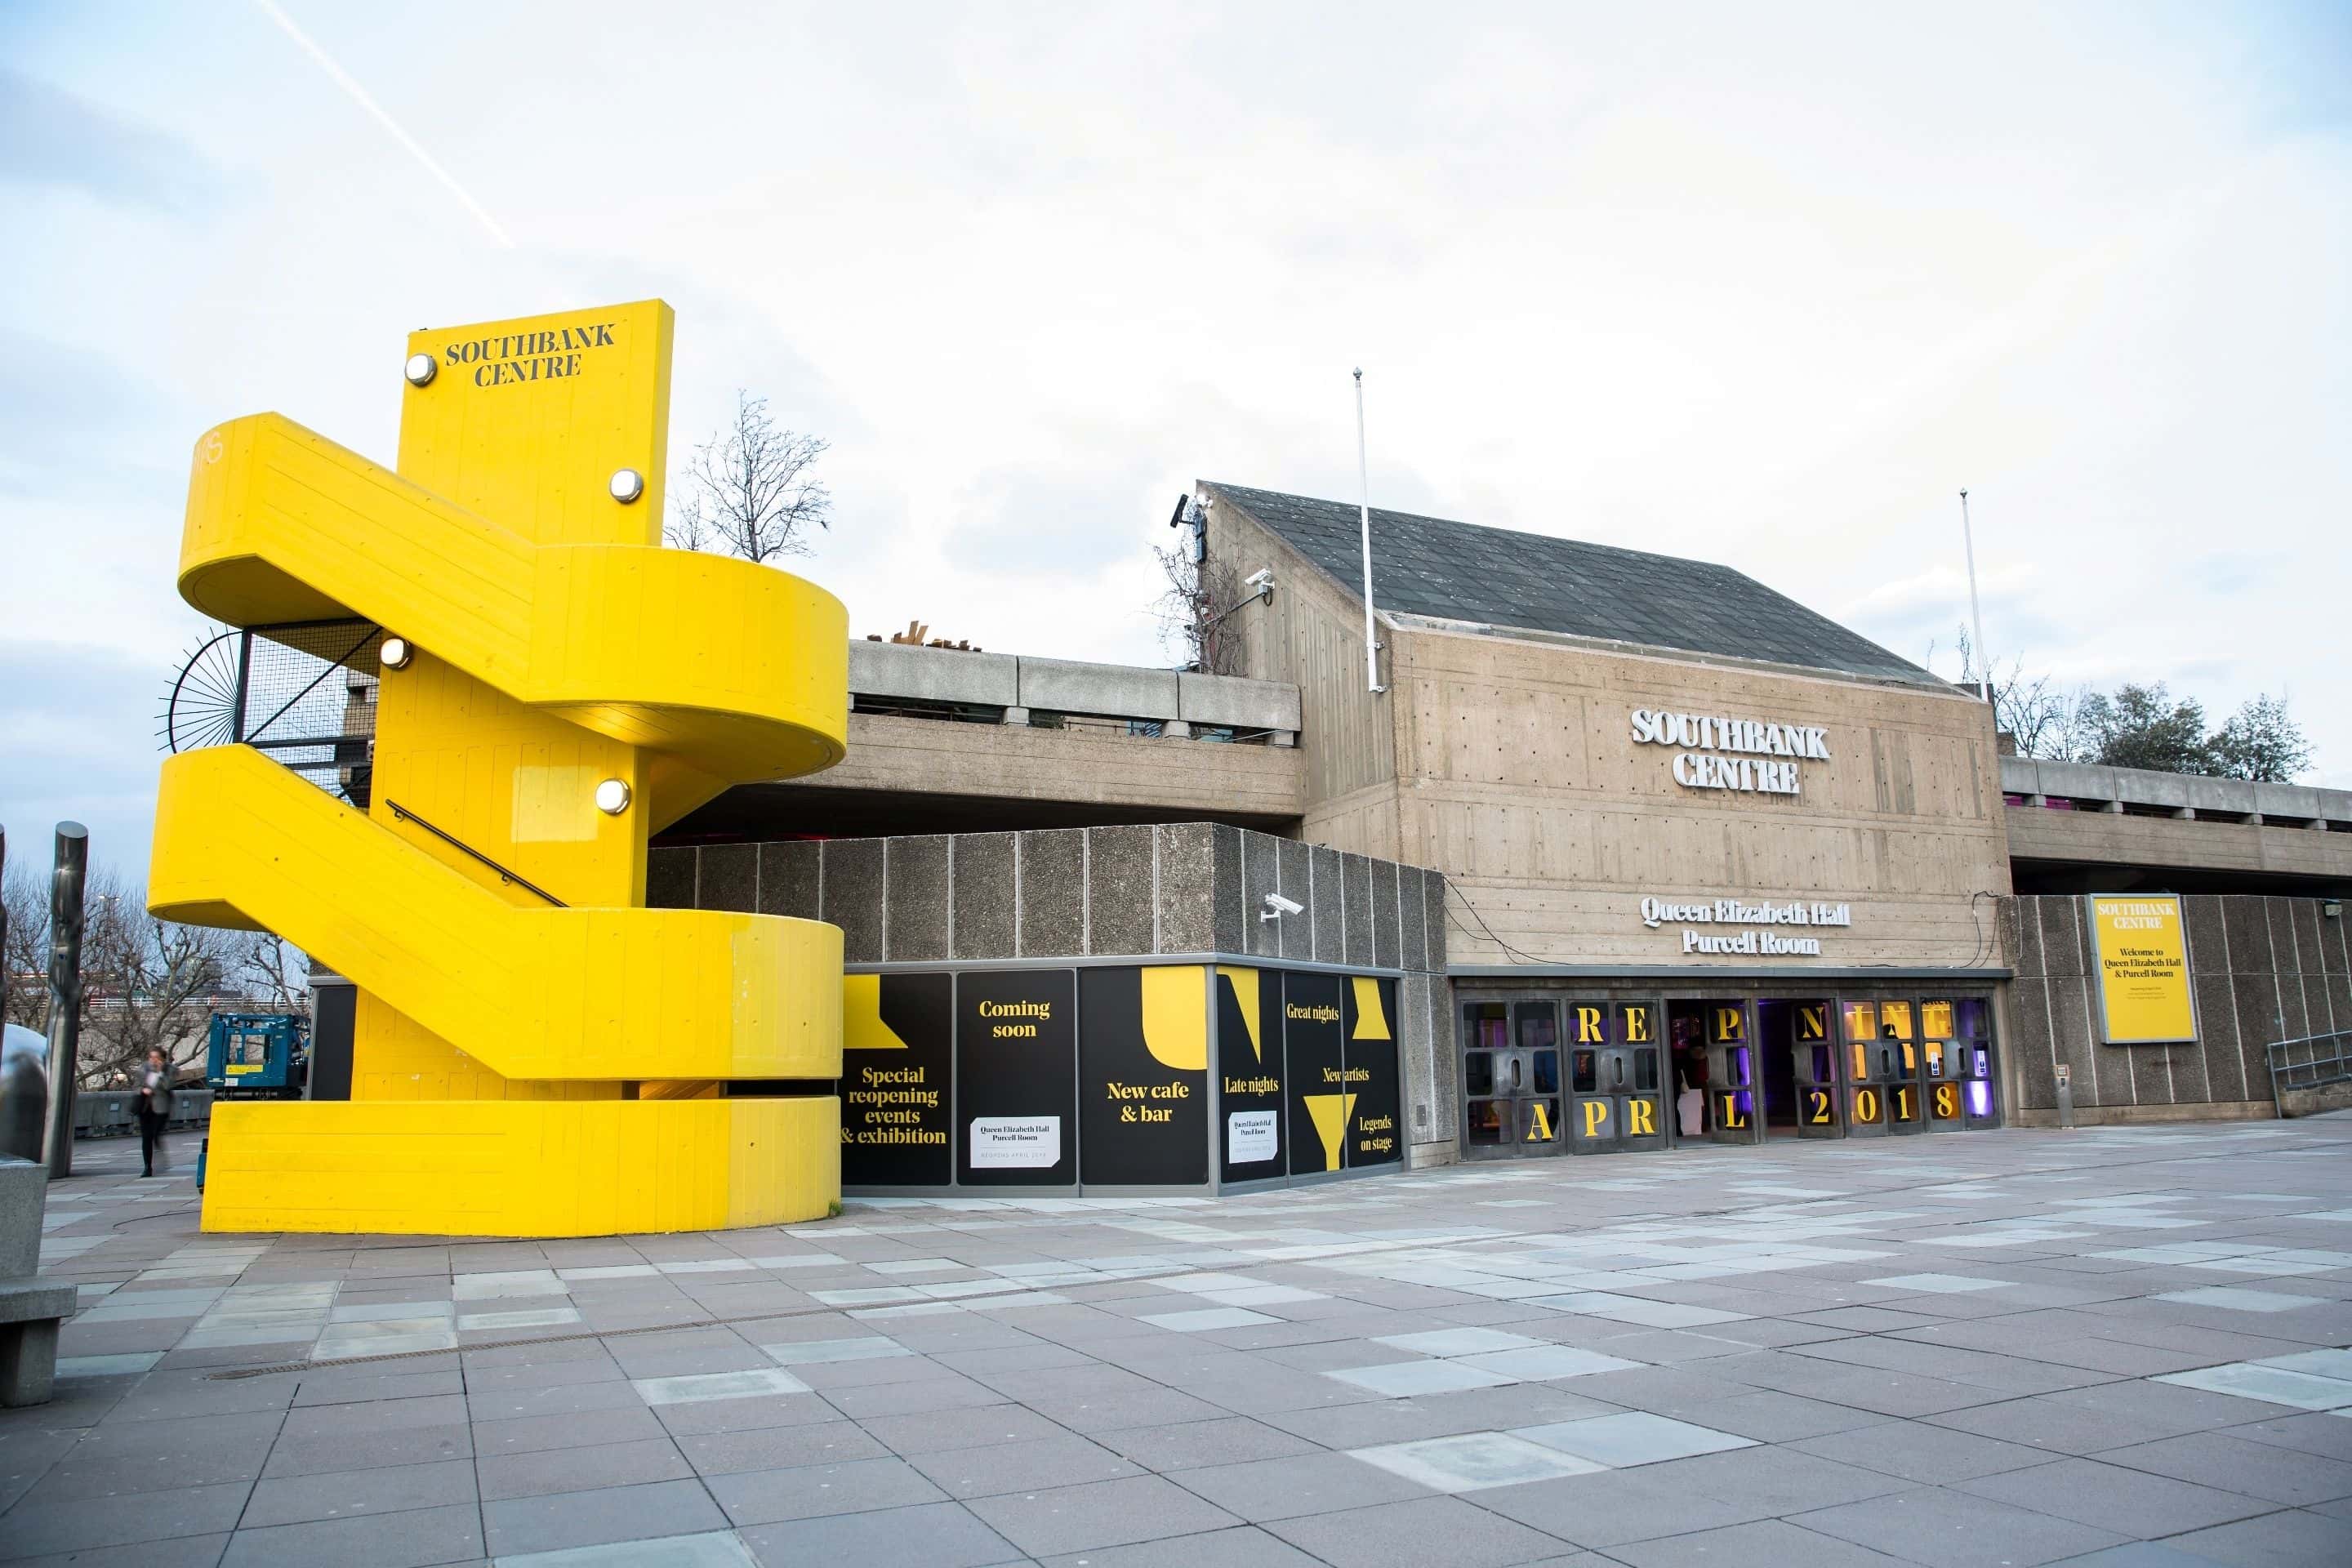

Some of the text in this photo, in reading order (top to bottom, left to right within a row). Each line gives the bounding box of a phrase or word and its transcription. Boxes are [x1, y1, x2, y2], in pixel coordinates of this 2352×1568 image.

[447, 324, 616, 367] SOUTHBANK
[474, 354, 581, 386] CENTRE
[1632, 709, 1830, 759] SOUTHBANK
[1673, 753, 1800, 794] CENTRE
[1641, 898, 1851, 928] Queen Elizabeth Hall
[2098, 903, 2175, 915] SOUTHBANK
[2114, 916, 2163, 929] CENTRE
[1682, 929, 1820, 955] Purcell Room
[2120, 947, 2163, 956] Welcome to
[2105, 958, 2181, 969] Queen Elizabeth Hall
[2115, 969, 2174, 978] & Purcell Room
[980, 1000, 1050, 1020] Coming
[1287, 1003, 1339, 1024] Great nights
[993, 1023, 1036, 1038] soon
[862, 1067, 924, 1088] Special
[1323, 1067, 1370, 1083] New artists
[1107, 1082, 1189, 1099] New cafe
[1225, 1076, 1279, 1097] Late nights
[849, 1087, 938, 1107] reopening
[1809, 1086, 1953, 1124] 2018
[865, 1109, 920, 1124] events
[1120, 1106, 1173, 1123] & bar
[980, 1125, 1002, 1134] Queen
[1036, 1125, 1049, 1133] Hall
[1359, 1116, 1392, 1132] Legends
[841, 1127, 946, 1144] & exhibition
[1361, 1136, 1392, 1153] on stage
